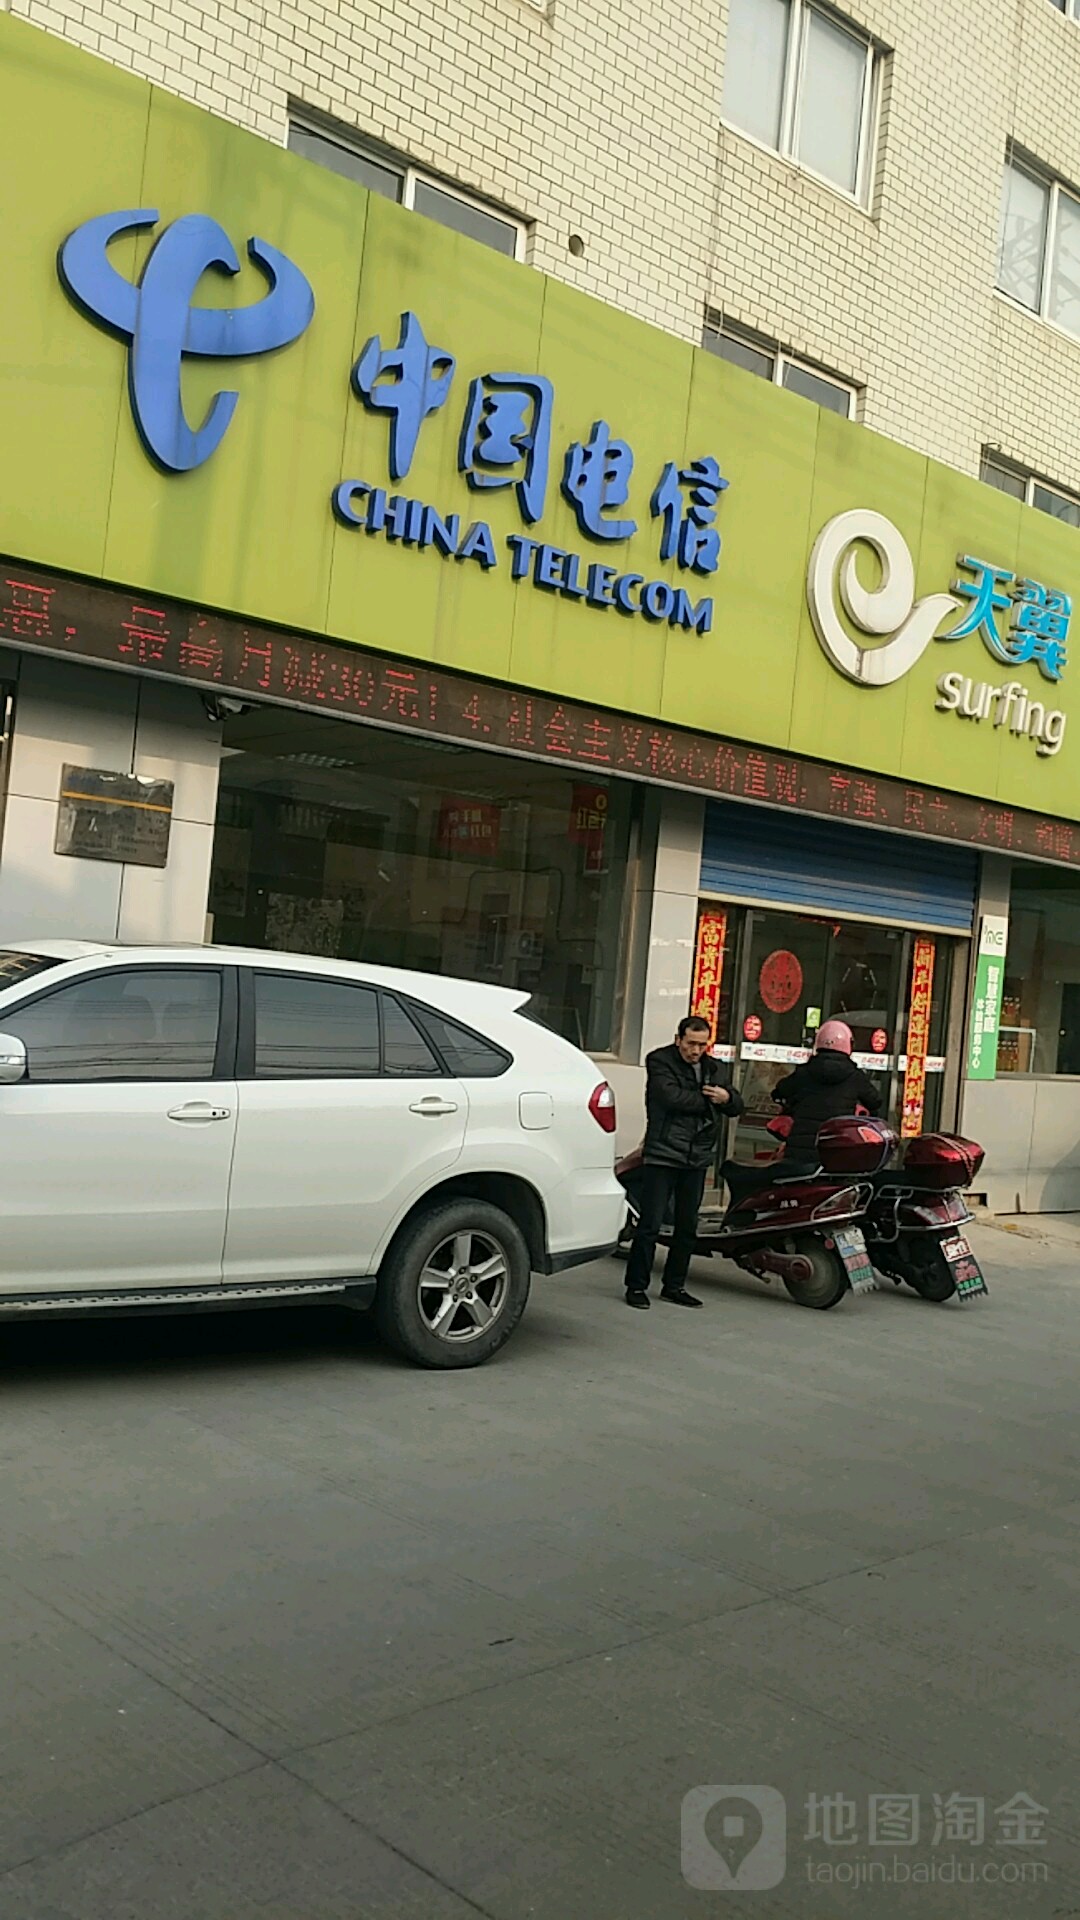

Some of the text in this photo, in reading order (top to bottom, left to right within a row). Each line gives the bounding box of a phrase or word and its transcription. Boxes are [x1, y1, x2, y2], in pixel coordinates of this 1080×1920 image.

[352, 311, 728, 574] 中国电信
[333, 480, 713, 634] CHINA TELECOM
[934, 552, 1074, 684] 天翼
[936, 671, 1068, 756] surfing
